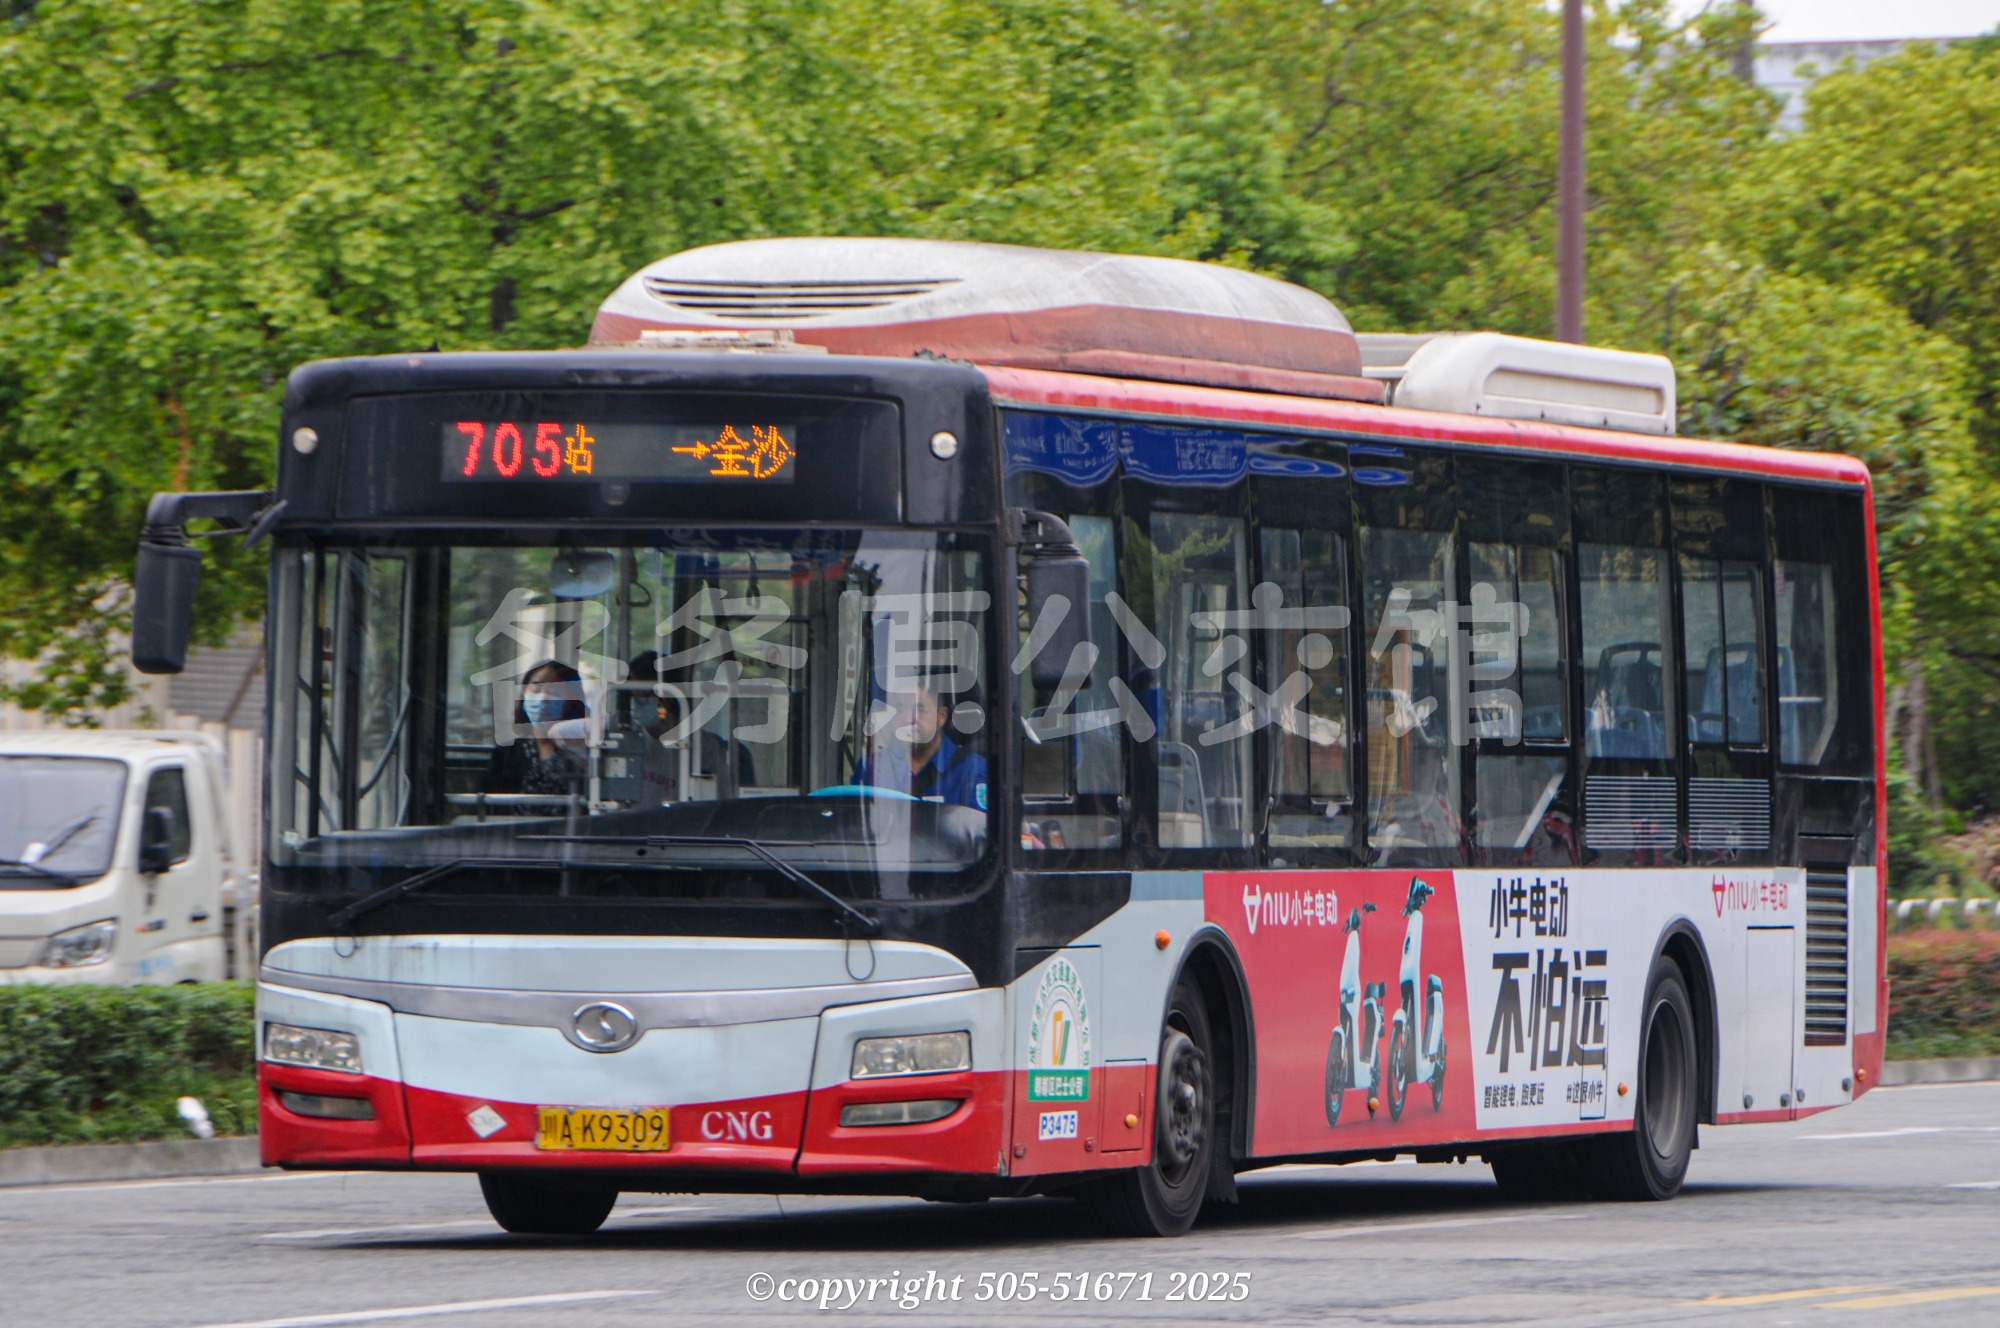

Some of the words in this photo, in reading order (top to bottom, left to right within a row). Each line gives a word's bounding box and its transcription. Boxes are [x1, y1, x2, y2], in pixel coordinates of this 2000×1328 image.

[1489, 877, 1569, 939] 小牛电动
[1486, 948, 1609, 1073] 不怕远
[701, 1110, 773, 1140] CNG
[1041, 1114, 1076, 1136] P3475
